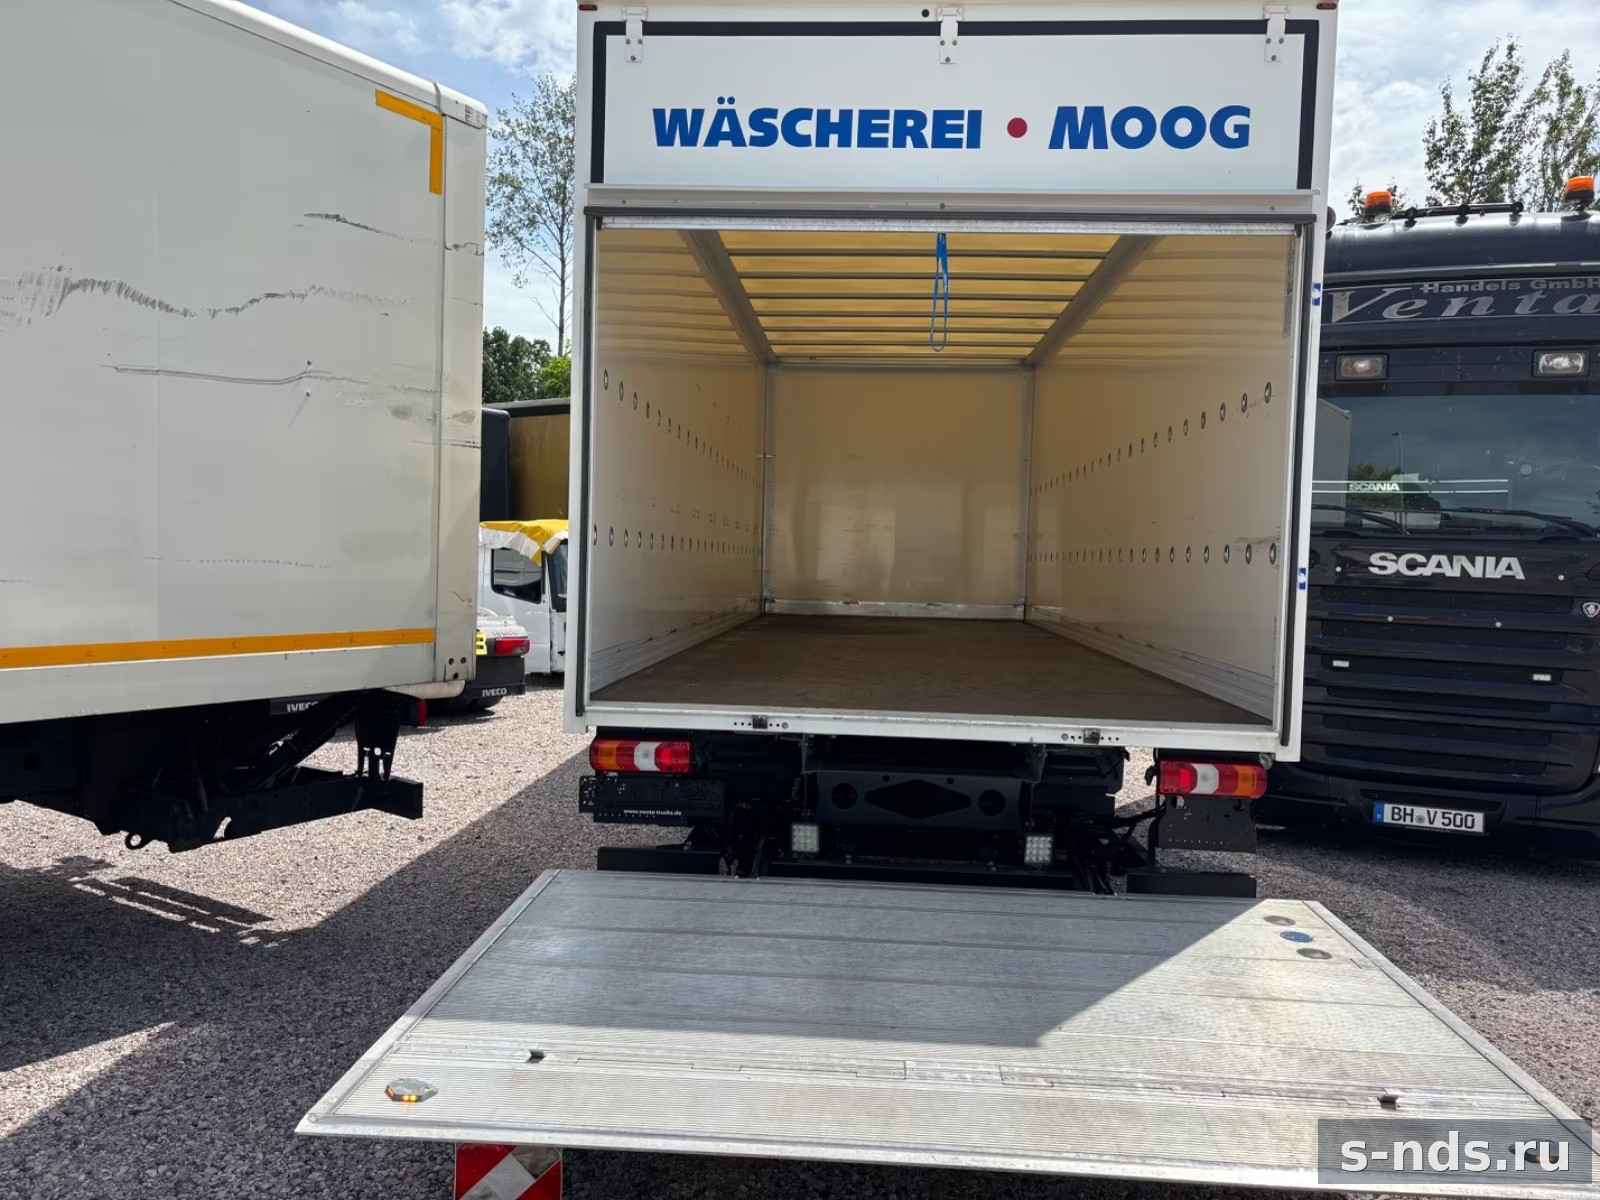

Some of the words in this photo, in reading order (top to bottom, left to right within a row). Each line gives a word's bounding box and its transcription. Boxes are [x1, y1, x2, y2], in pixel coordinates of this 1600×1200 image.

[653, 96, 982, 149] WÄSCHEREI
[1048, 105, 1251, 149] MOOG
[1422, 280, 1521, 294] Handels
[1529, 278, 1600, 290] GmbH
[1328, 287, 1600, 323] Venta
[1349, 482, 1400, 491] SCANIA
[1368, 551, 1526, 580] SCANIA
[482, 687, 508, 697] IVECO
[286, 700, 319, 713] IVEC
[1391, 806, 1415, 823] BH
[1441, 811, 1475, 829] 500
